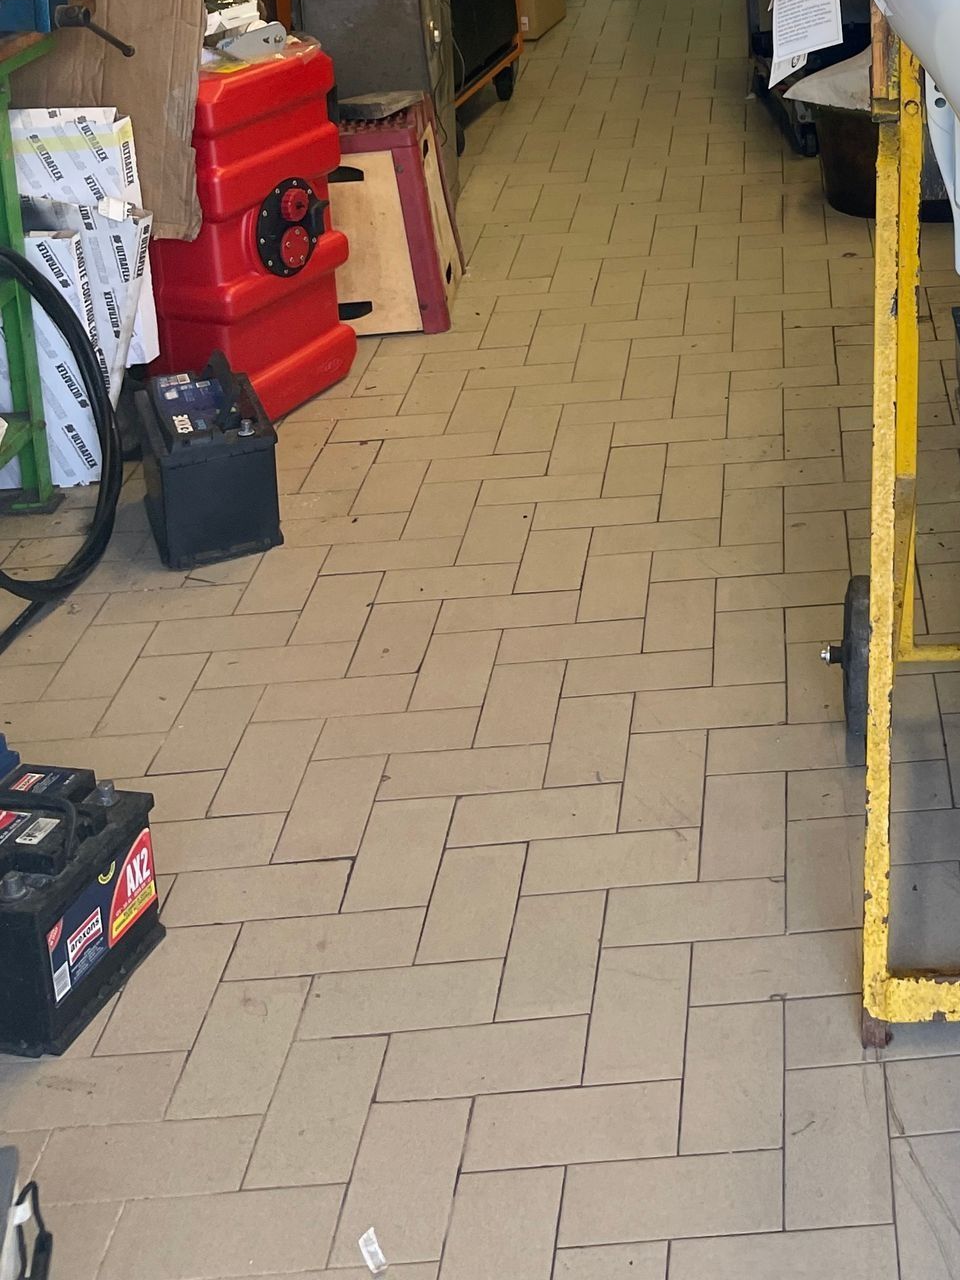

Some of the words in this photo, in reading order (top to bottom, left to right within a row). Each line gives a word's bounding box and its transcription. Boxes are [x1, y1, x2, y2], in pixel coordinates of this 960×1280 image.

[37, 143, 64, 182] ULTRAFLEX
[81, 124, 109, 162] ULTRAFLEX
[122, 141, 135, 186] ULTRAFLEX
[84, 175, 105, 201] RAFLEX
[36, 241, 64, 280] ULTRAFLEX
[75, 239, 88, 281] REMOTE
[136, 237, 149, 279] ULTRAFLEX
[81, 281, 97, 327] CONTROL
[104, 290, 120, 329] ULTRAFLEX
[55, 363, 83, 400] ULTRAFLEX
[71, 433, 98, 469] ULTRAFLEX
[126, 847, 151, 897] AX2
[69, 916, 101, 953] arexons
